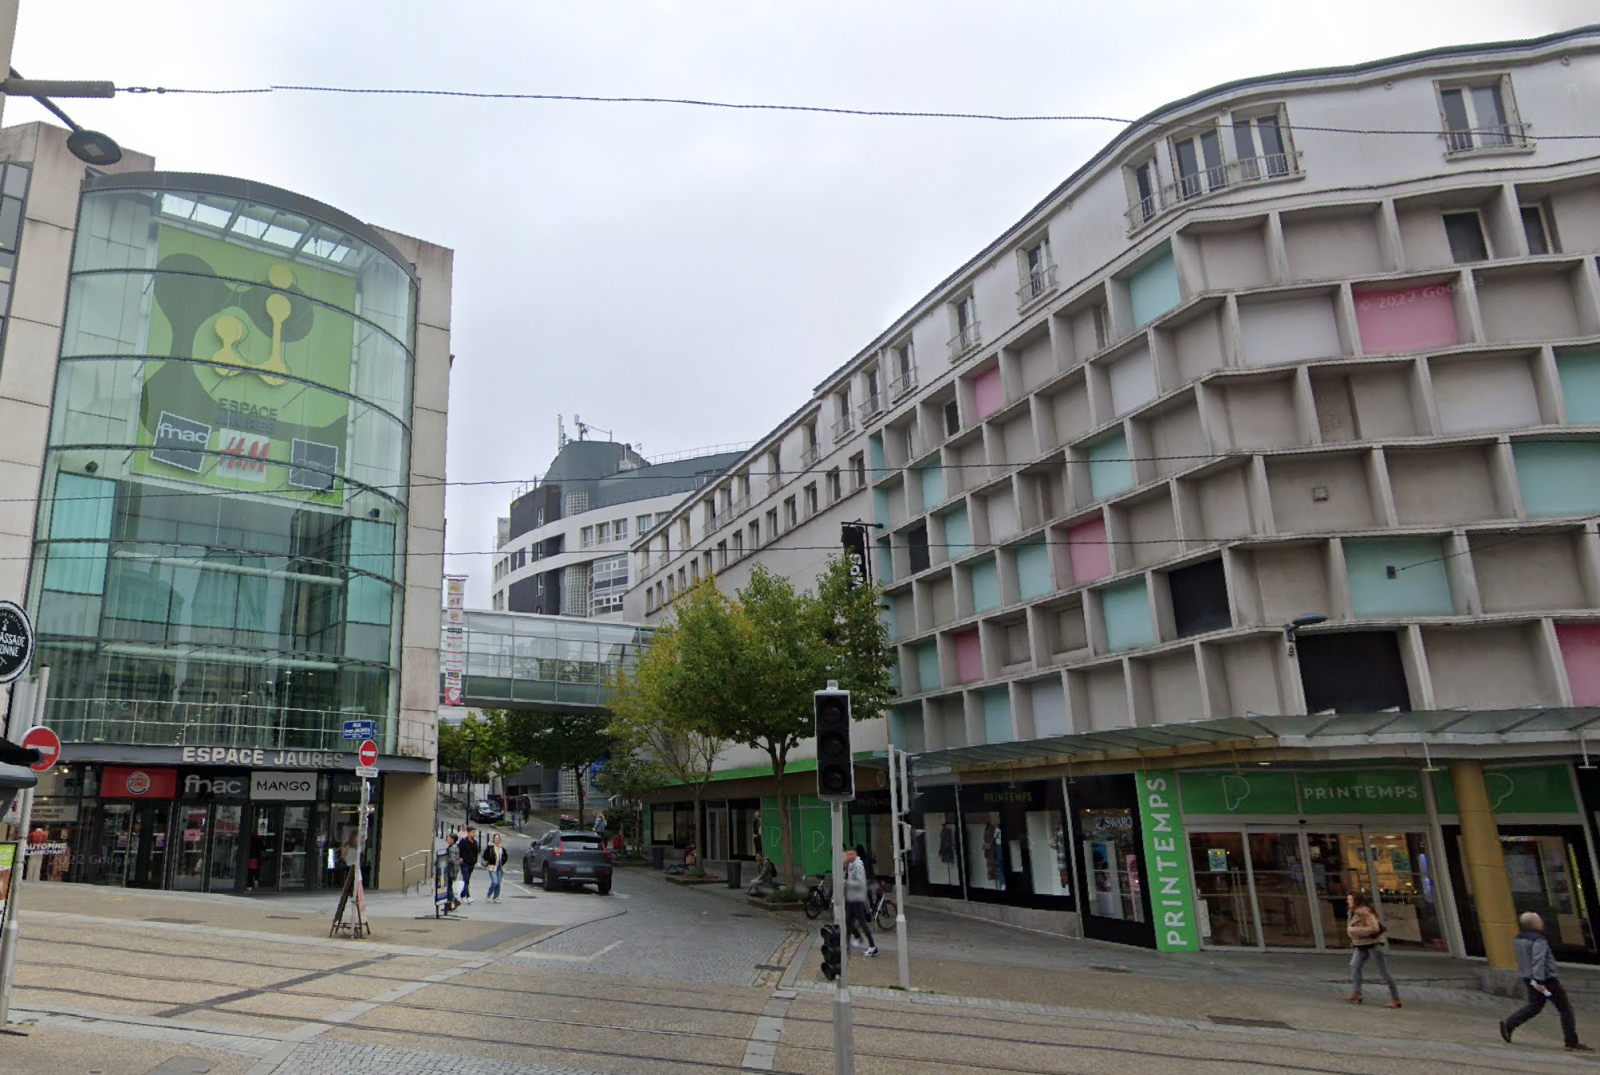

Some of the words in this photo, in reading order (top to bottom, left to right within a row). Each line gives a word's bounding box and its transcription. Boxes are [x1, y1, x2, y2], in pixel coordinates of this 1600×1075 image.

[218, 397, 278, 421] ESPACE
[159, 422, 209, 443] fnac
[182, 747, 264, 765] ESPACE
[274, 751, 344, 767] JAURES
[185, 775, 241, 794] fnac
[257, 781, 311, 792] MANGO
[338, 784, 376, 794] PROVT
[1304, 785, 1418, 799] PRINTEMPS
[984, 792, 1032, 803] PRINTEMPS
[1146, 777, 1188, 946] PRINTEMPS
